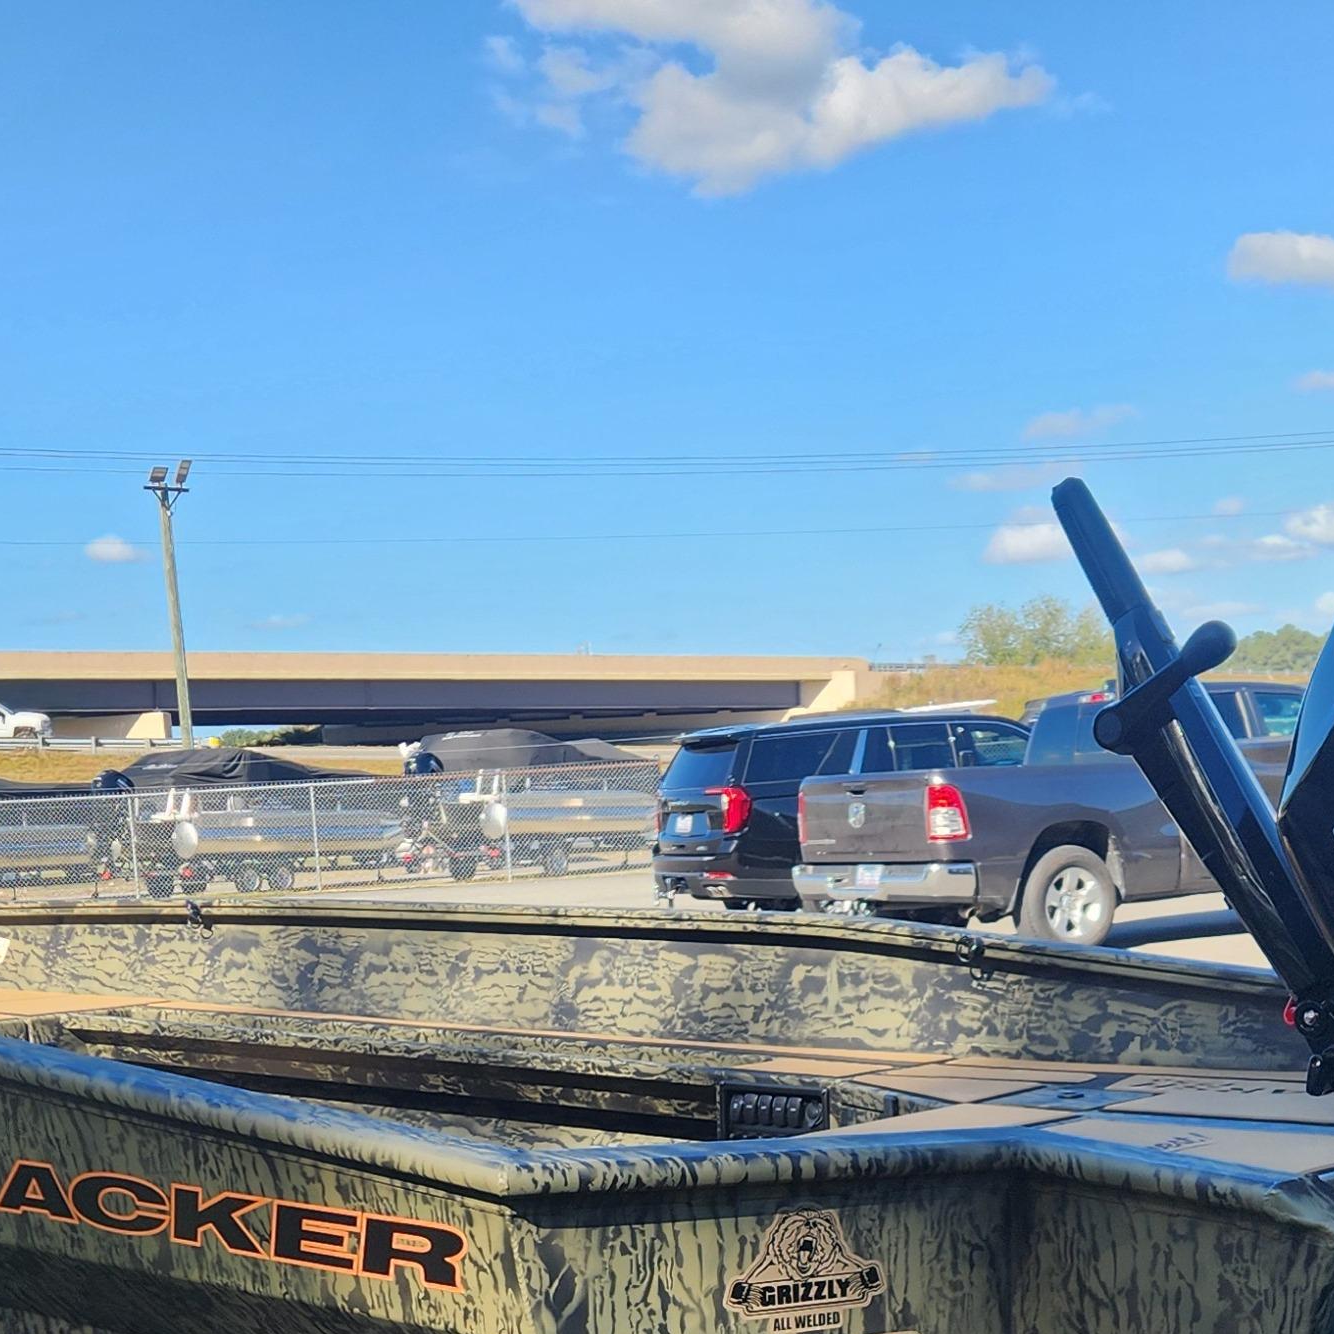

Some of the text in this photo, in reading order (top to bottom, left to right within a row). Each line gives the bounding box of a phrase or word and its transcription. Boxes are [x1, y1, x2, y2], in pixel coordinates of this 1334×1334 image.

[761, 1280, 852, 1307] GRIZZLY
[773, 1311, 841, 1332] ALL WELDED
